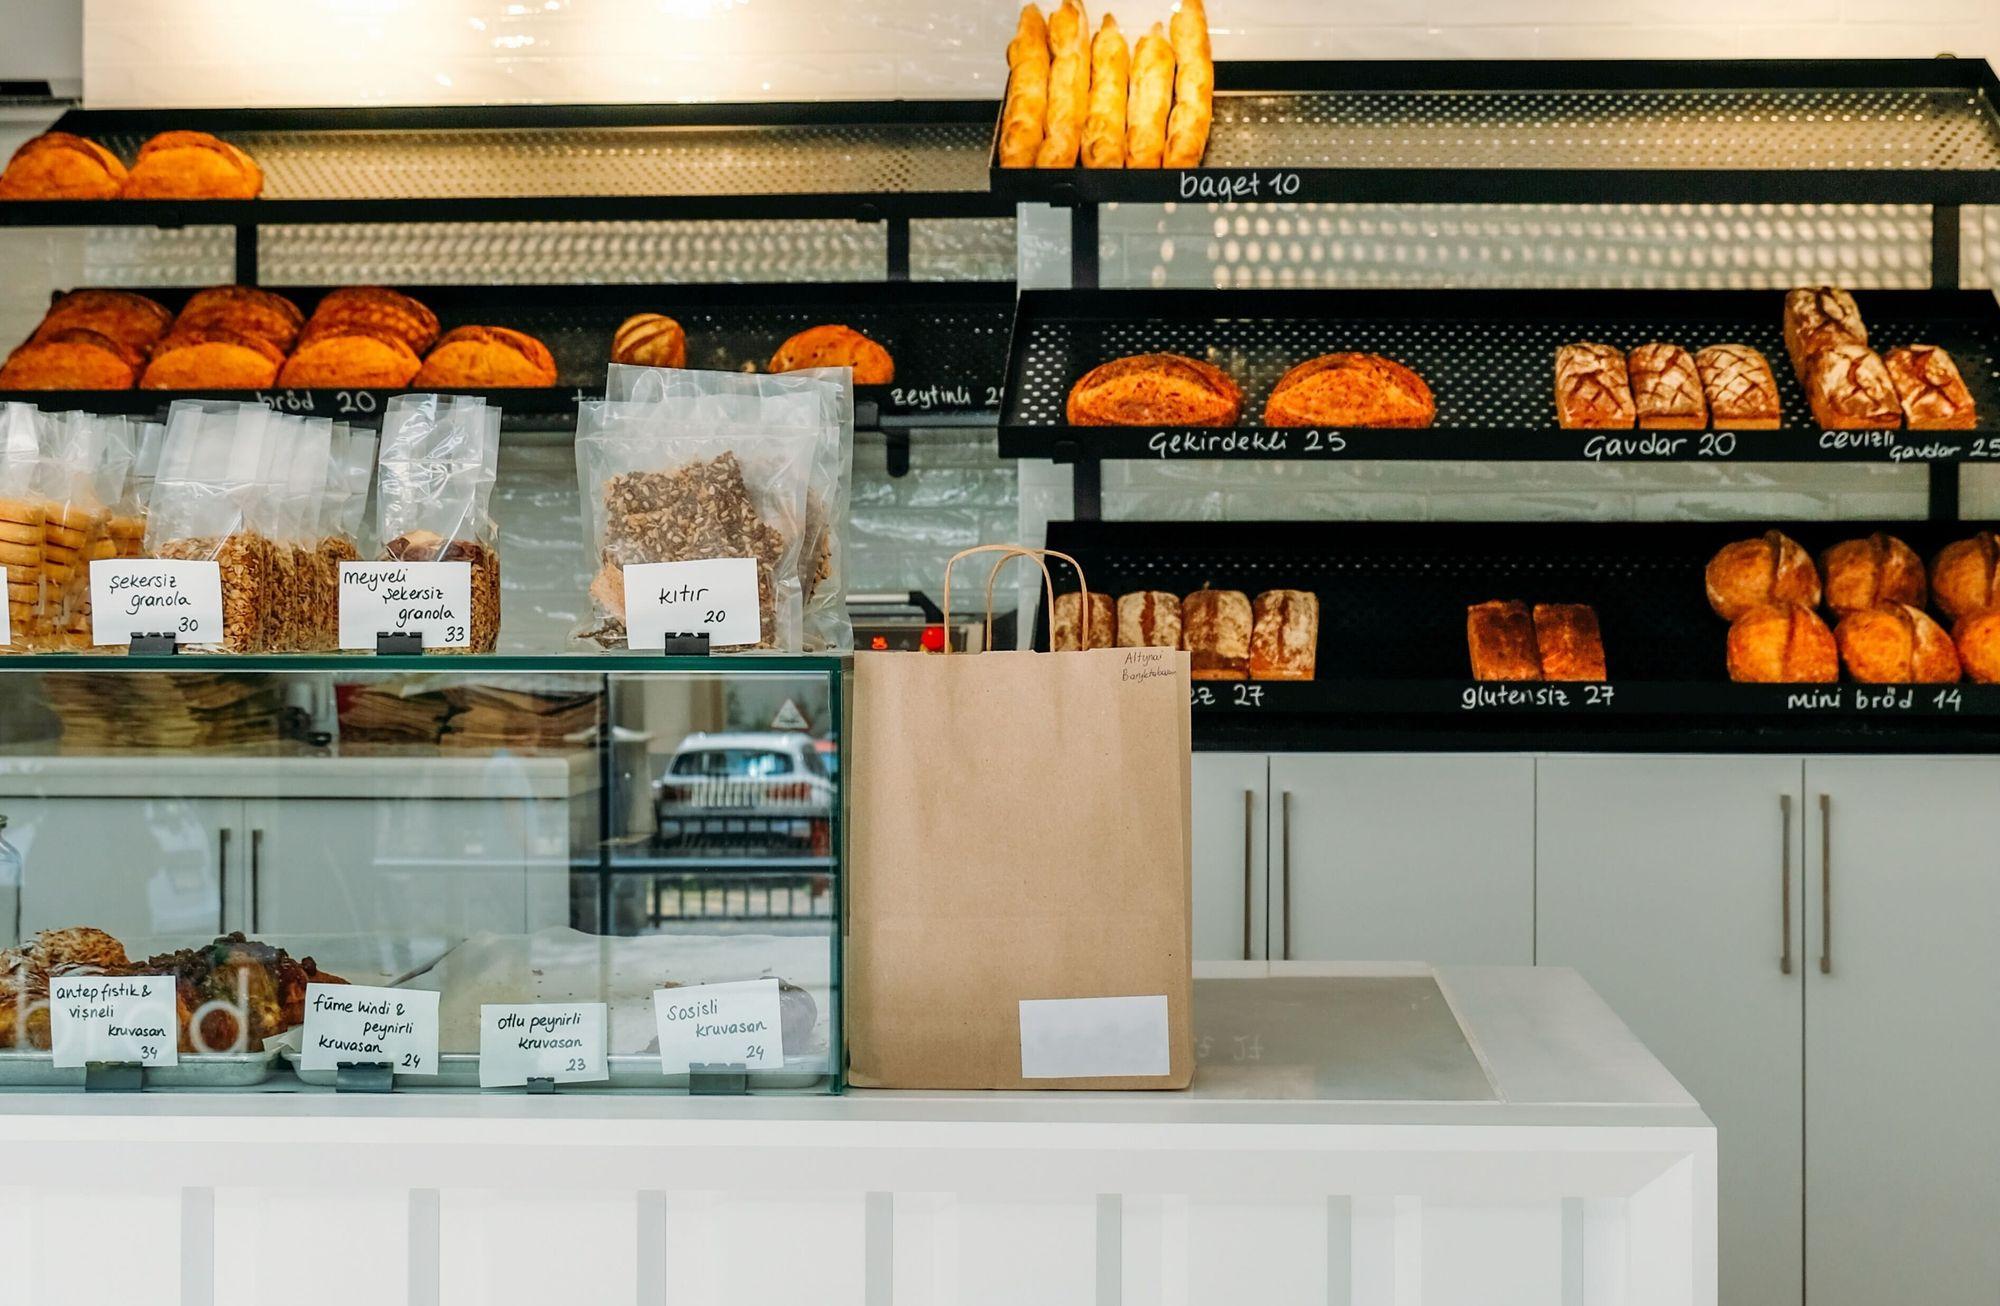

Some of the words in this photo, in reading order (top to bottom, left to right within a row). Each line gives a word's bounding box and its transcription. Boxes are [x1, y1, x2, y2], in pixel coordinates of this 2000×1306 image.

[1180, 171, 1260, 202] baget
[1268, 173, 1300, 195] 10
[336, 391, 377, 413] 20
[890, 384, 972, 410] zeytinli
[1304, 430, 1346, 451] 25
[1699, 432, 1736, 456] 20
[1969, 438, 2000, 457] 25
[109, 574, 177, 594] şekersiz
[343, 568, 409, 592] meyveli
[125, 591, 192, 616] granola
[382, 586, 444, 604] şekersiz
[658, 584, 709, 604] kıtır
[178, 616, 199, 632] 30
[396, 604, 455, 628] granola
[703, 610, 726, 623] 20
[445, 626, 465, 642] 33
[1233, 684, 1265, 706] 27
[1461, 685, 1570, 709] glutensiz
[1584, 685, 1615, 705] 27
[1788, 687, 1842, 709] mini
[1856, 686, 1913, 710] bröd
[1932, 688, 1962, 712] 14
[141, 984, 152, 997] &
[69, 1004, 114, 1021] vişneli
[358, 1001, 391, 1015] hindi
[396, 1003, 405, 1016] &
[108, 1024, 166, 1037] kruvasan
[363, 1022, 413, 1040] peynirli
[498, 1013, 525, 1029] otlu
[529, 1012, 582, 1033] peynirli
[695, 1021, 767, 1037] kruvasan
[141, 1045, 158, 1059] 34
[319, 1034, 383, 1053] kruvasan
[518, 1037, 583, 1050] kruvasan
[746, 1045, 765, 1060] 24
[401, 1053, 421, 1068] 24
[566, 1058, 586, 1071] 23
